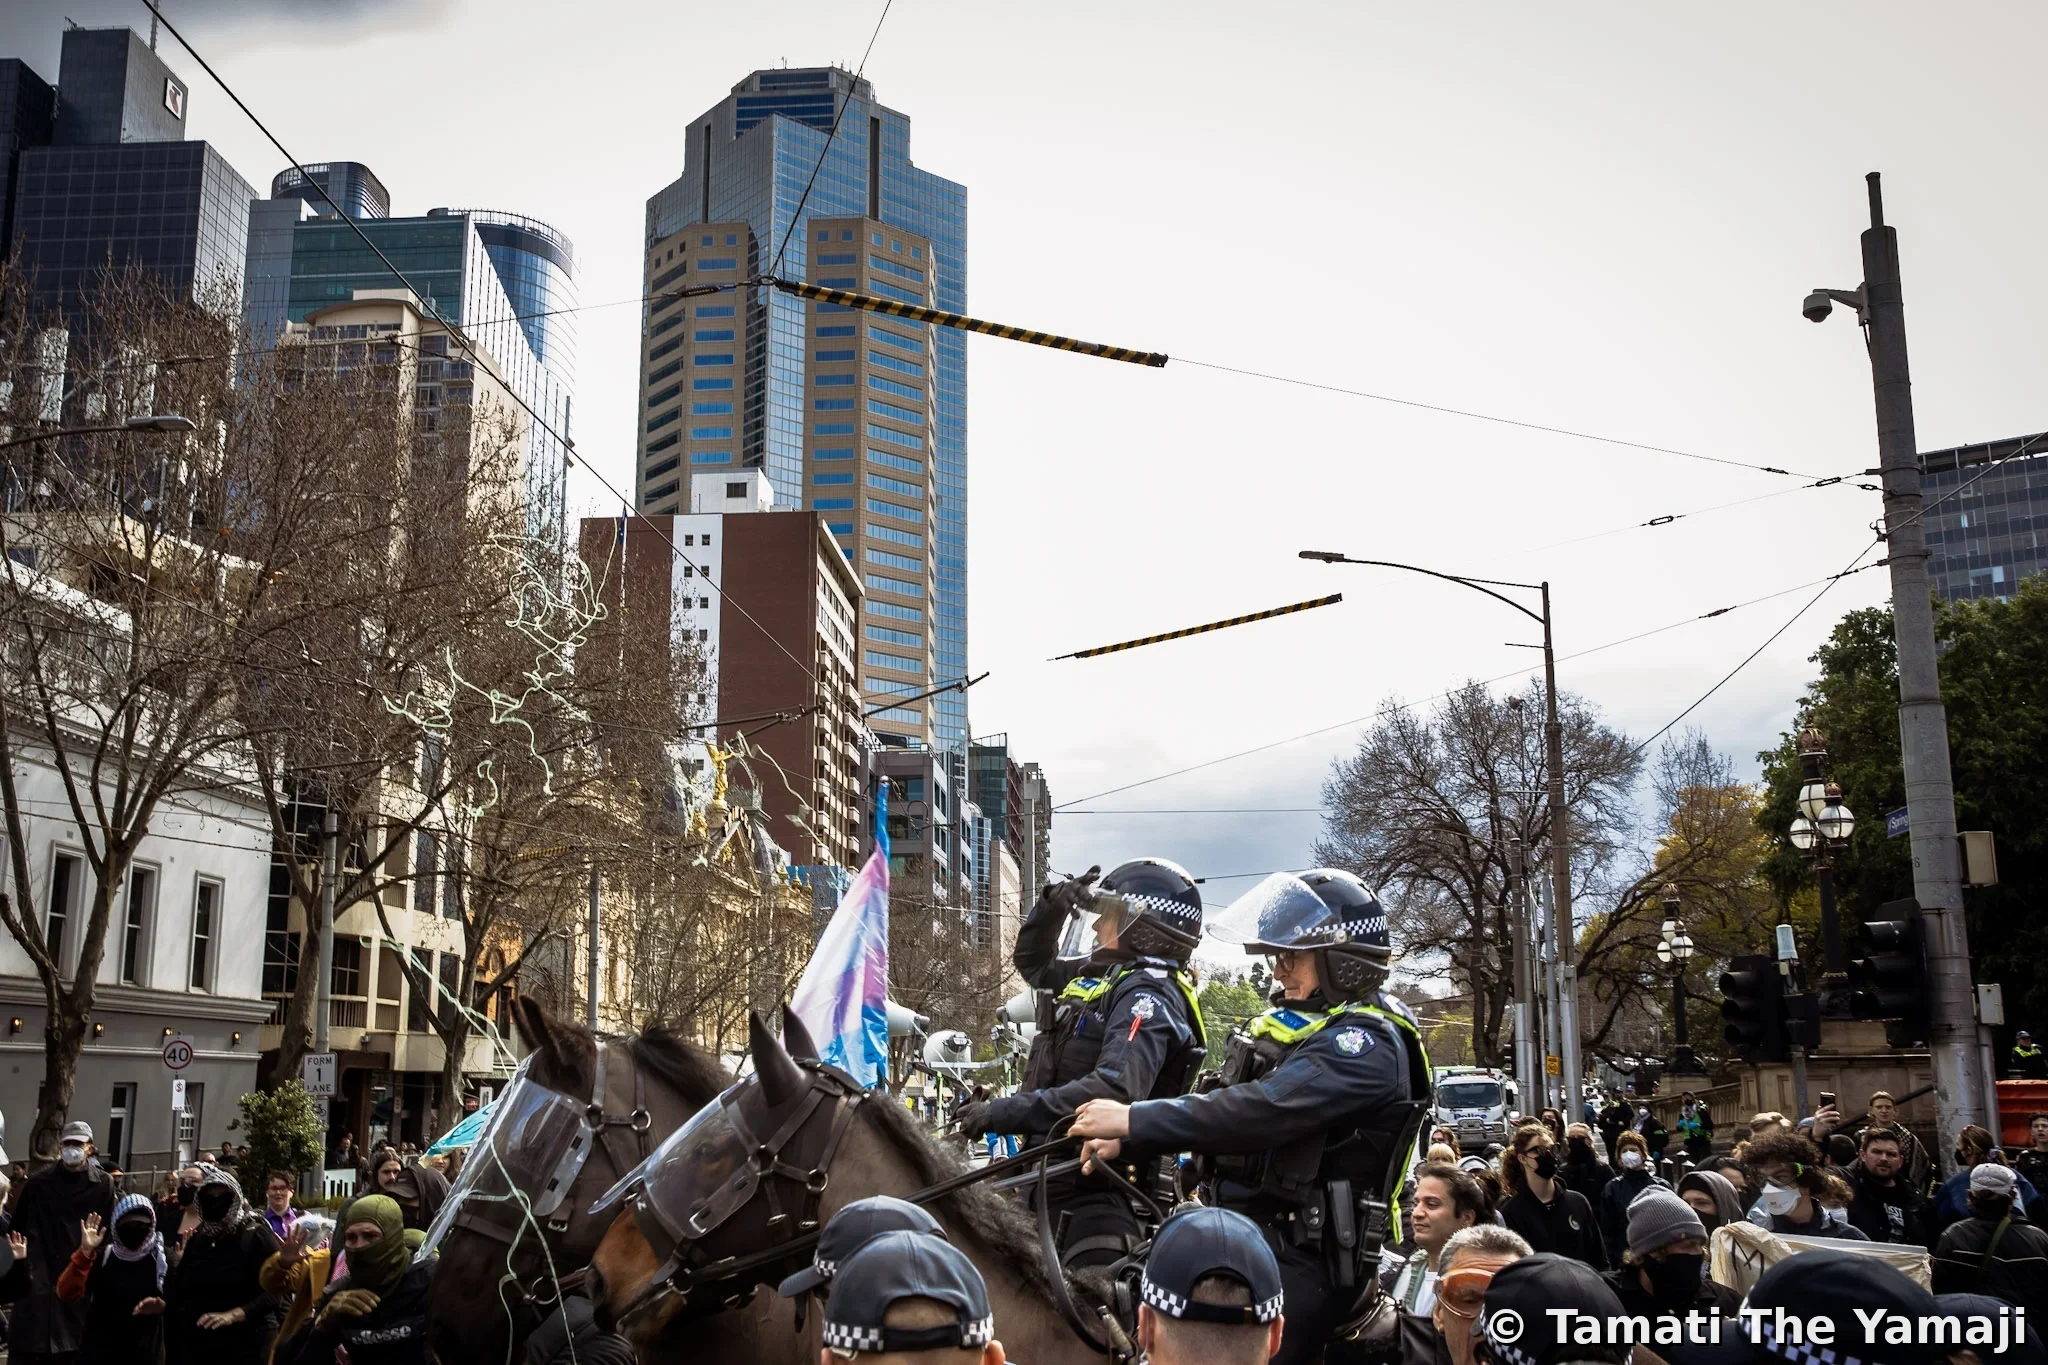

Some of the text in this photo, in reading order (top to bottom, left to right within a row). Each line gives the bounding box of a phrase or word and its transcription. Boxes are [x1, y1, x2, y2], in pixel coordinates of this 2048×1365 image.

[167, 1047, 189, 1062] 40
[307, 1055, 332, 1065] FORM
[316, 1067, 321, 1082] 1
[307, 1084, 332, 1093] LANE
[352, 1325, 412, 1345] ellesse
